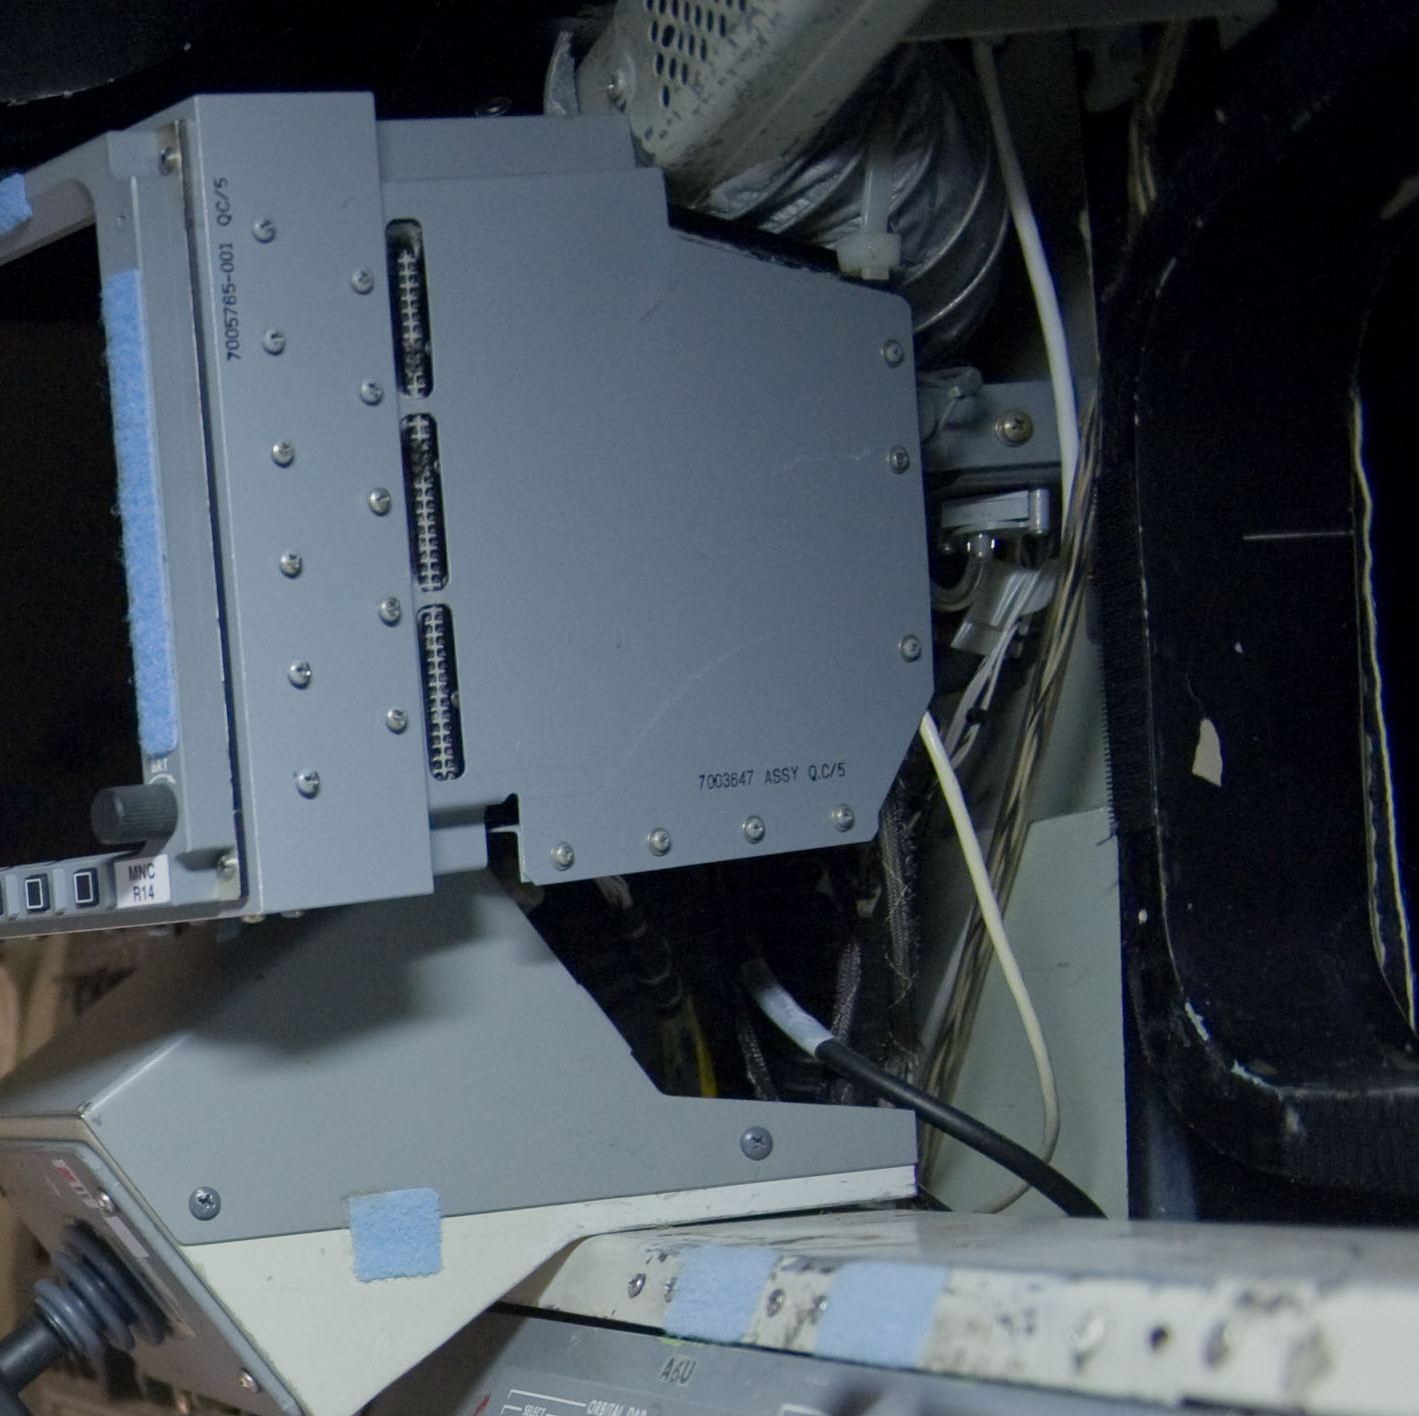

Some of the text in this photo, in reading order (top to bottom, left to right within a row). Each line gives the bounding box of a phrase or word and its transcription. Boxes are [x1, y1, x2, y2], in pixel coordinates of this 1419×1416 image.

[213, 177, 242, 362] 7005765-001 QC/5
[698, 769, 755, 791] 7003647
[764, 765, 799, 785] ASSY
[128, 862, 156, 882] MNC
[132, 884, 156, 902] R14
[659, 1357, 698, 1385] A6U
